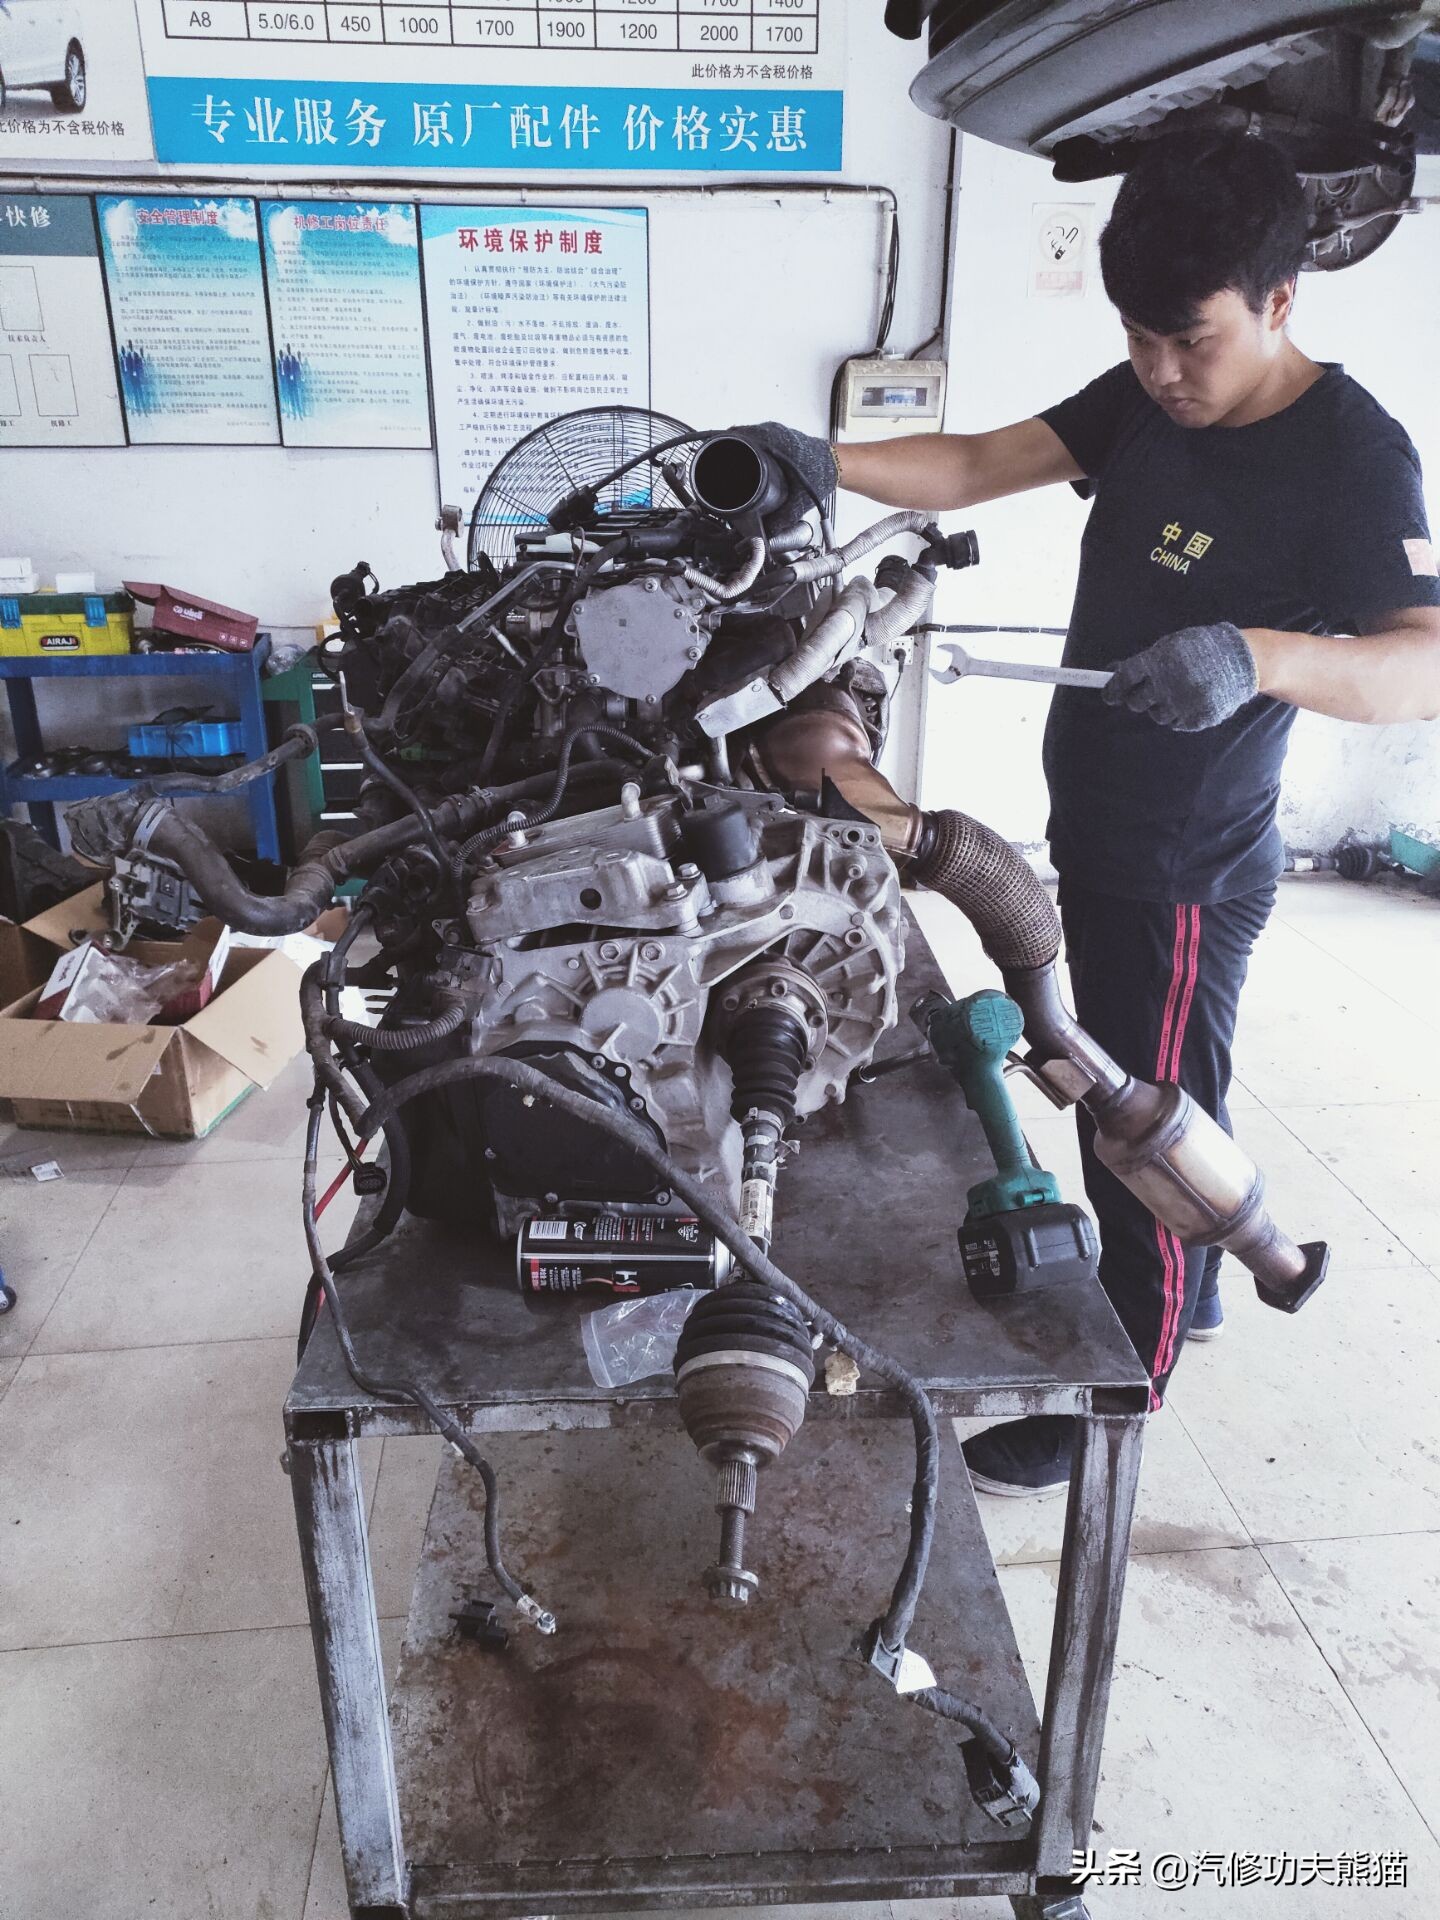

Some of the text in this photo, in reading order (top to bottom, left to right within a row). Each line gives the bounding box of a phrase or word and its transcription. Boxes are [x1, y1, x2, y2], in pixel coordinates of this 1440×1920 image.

[190, 11, 802, 42] A8 5.0/6.0 450 1000 1700 1900 1200 2000 1700
[692, 64, 812, 79] 此价格为不含税价格
[191, 94, 807, 153] 专业服务 原厂配件 价格实惠
[0, 205, 51, 228] 快修
[136, 209, 218, 225] 安全管理制度
[294, 215, 386, 231] 机修工岗位责任
[458, 228, 603, 254] 环境保护制度
[1161, 522, 1214, 559] 中国
[1150, 547, 1192, 574] CHINA
